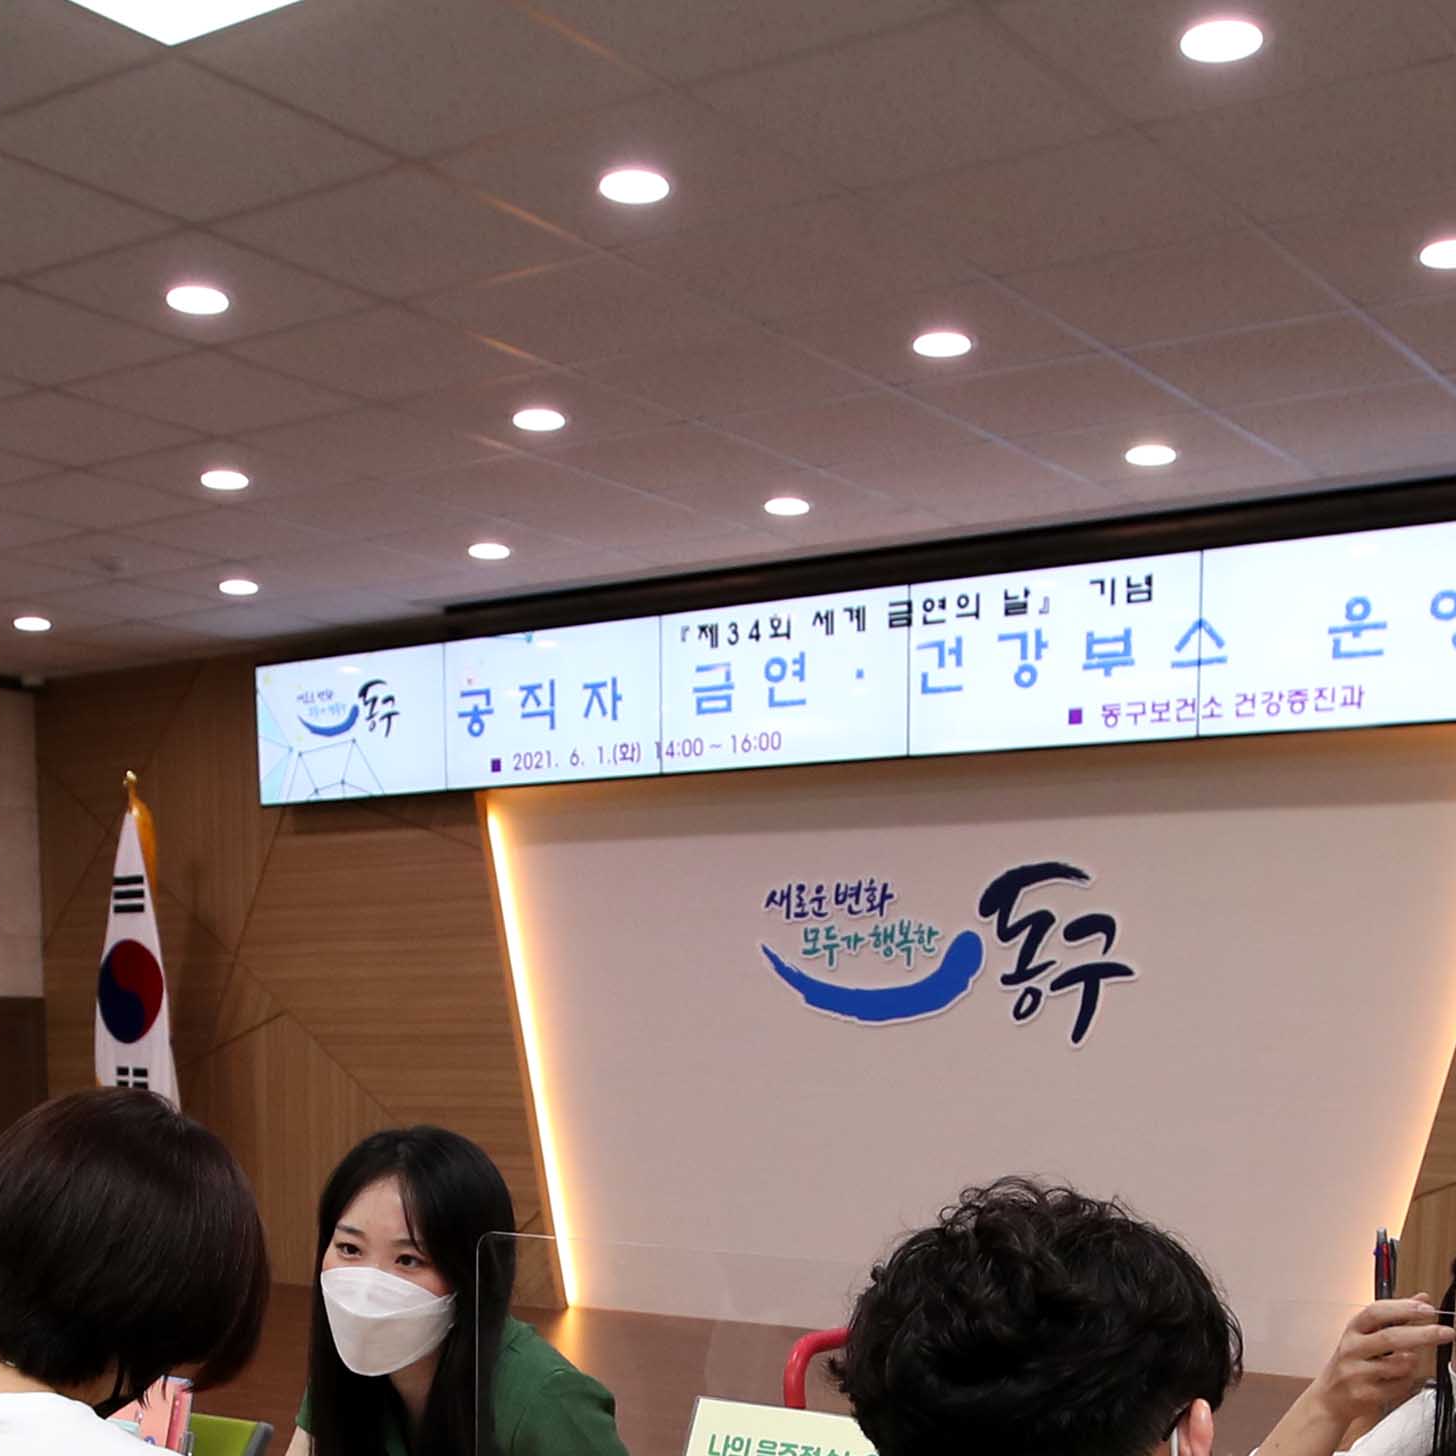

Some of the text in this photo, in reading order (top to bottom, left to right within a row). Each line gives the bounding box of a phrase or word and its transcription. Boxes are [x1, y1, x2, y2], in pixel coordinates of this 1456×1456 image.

[812, 605, 866, 636] 세계
[888, 592, 980, 629] 금연의
[1089, 573, 1153, 606] 기념
[358, 679, 400, 738] 동구
[457, 676, 624, 737] 공직자
[1101, 684, 1365, 728] 동구보건소 건강증진과
[655, 737, 704, 761] 14:00
[730, 731, 782, 755] 16:00
[764, 877, 894, 920] 새로운 변화
[801, 919, 940, 968] 모두가 행복한
[978, 861, 1135, 1044] 동구
